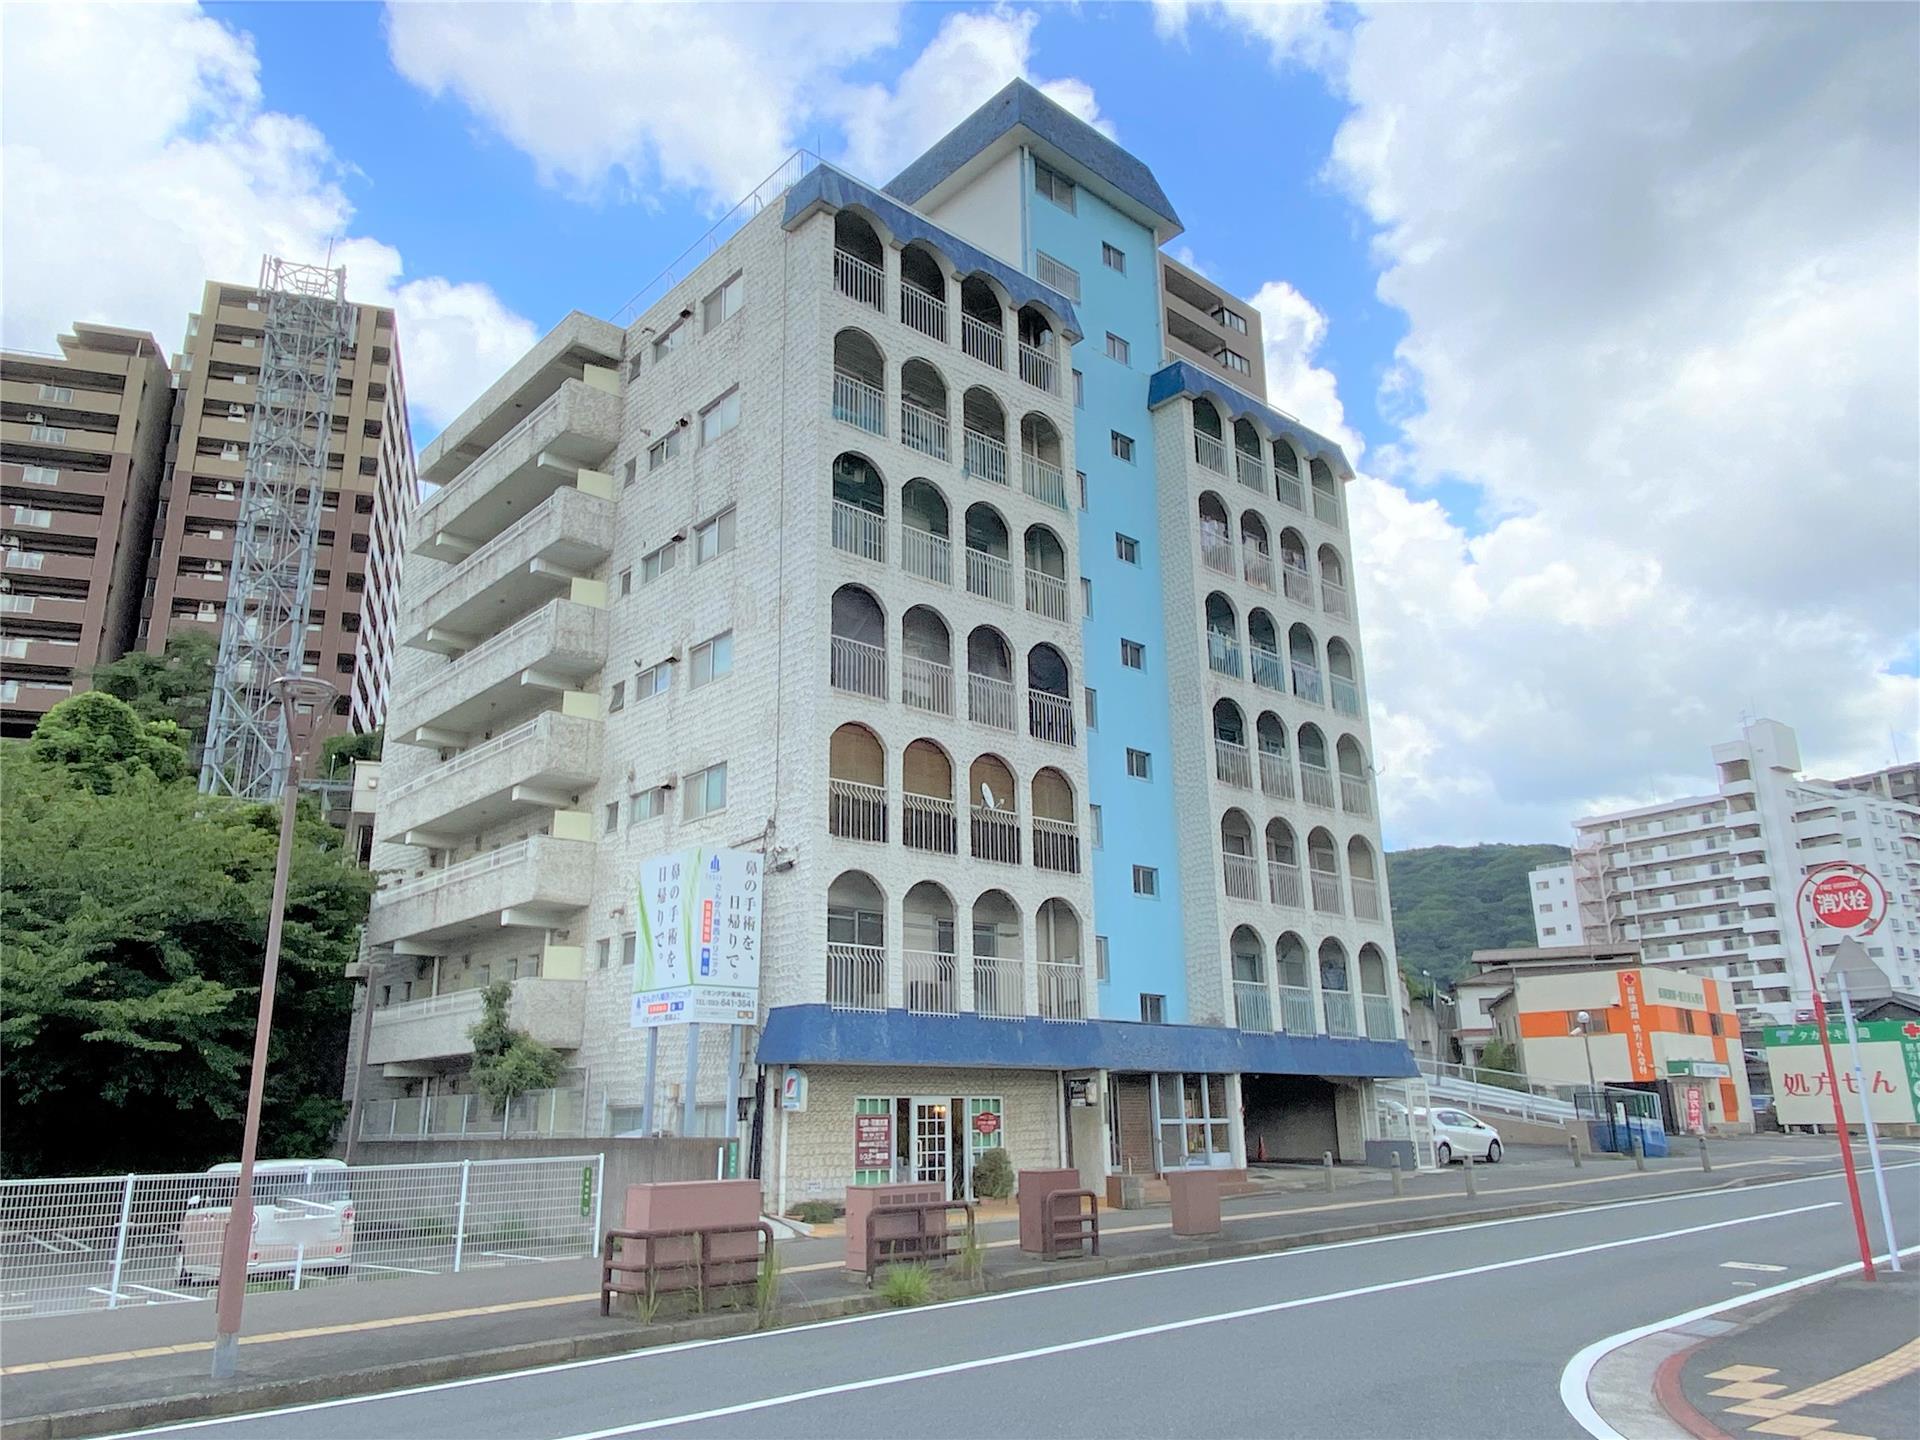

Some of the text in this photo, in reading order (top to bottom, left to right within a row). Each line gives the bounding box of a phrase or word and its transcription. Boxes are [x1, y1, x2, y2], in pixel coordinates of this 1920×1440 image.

[655, 866, 667, 960] 日帰りで。
[667, 862, 681, 979] 鼻の手術を、
[726, 895, 740, 980] 日帰りで。
[743, 860, 758, 961] 鼻の手術を、
[1816, 889, 1869, 915] 消火栓
[1798, 1027, 1871, 1041] タカキ局
[1783, 1070, 1897, 1097] 処方せん
